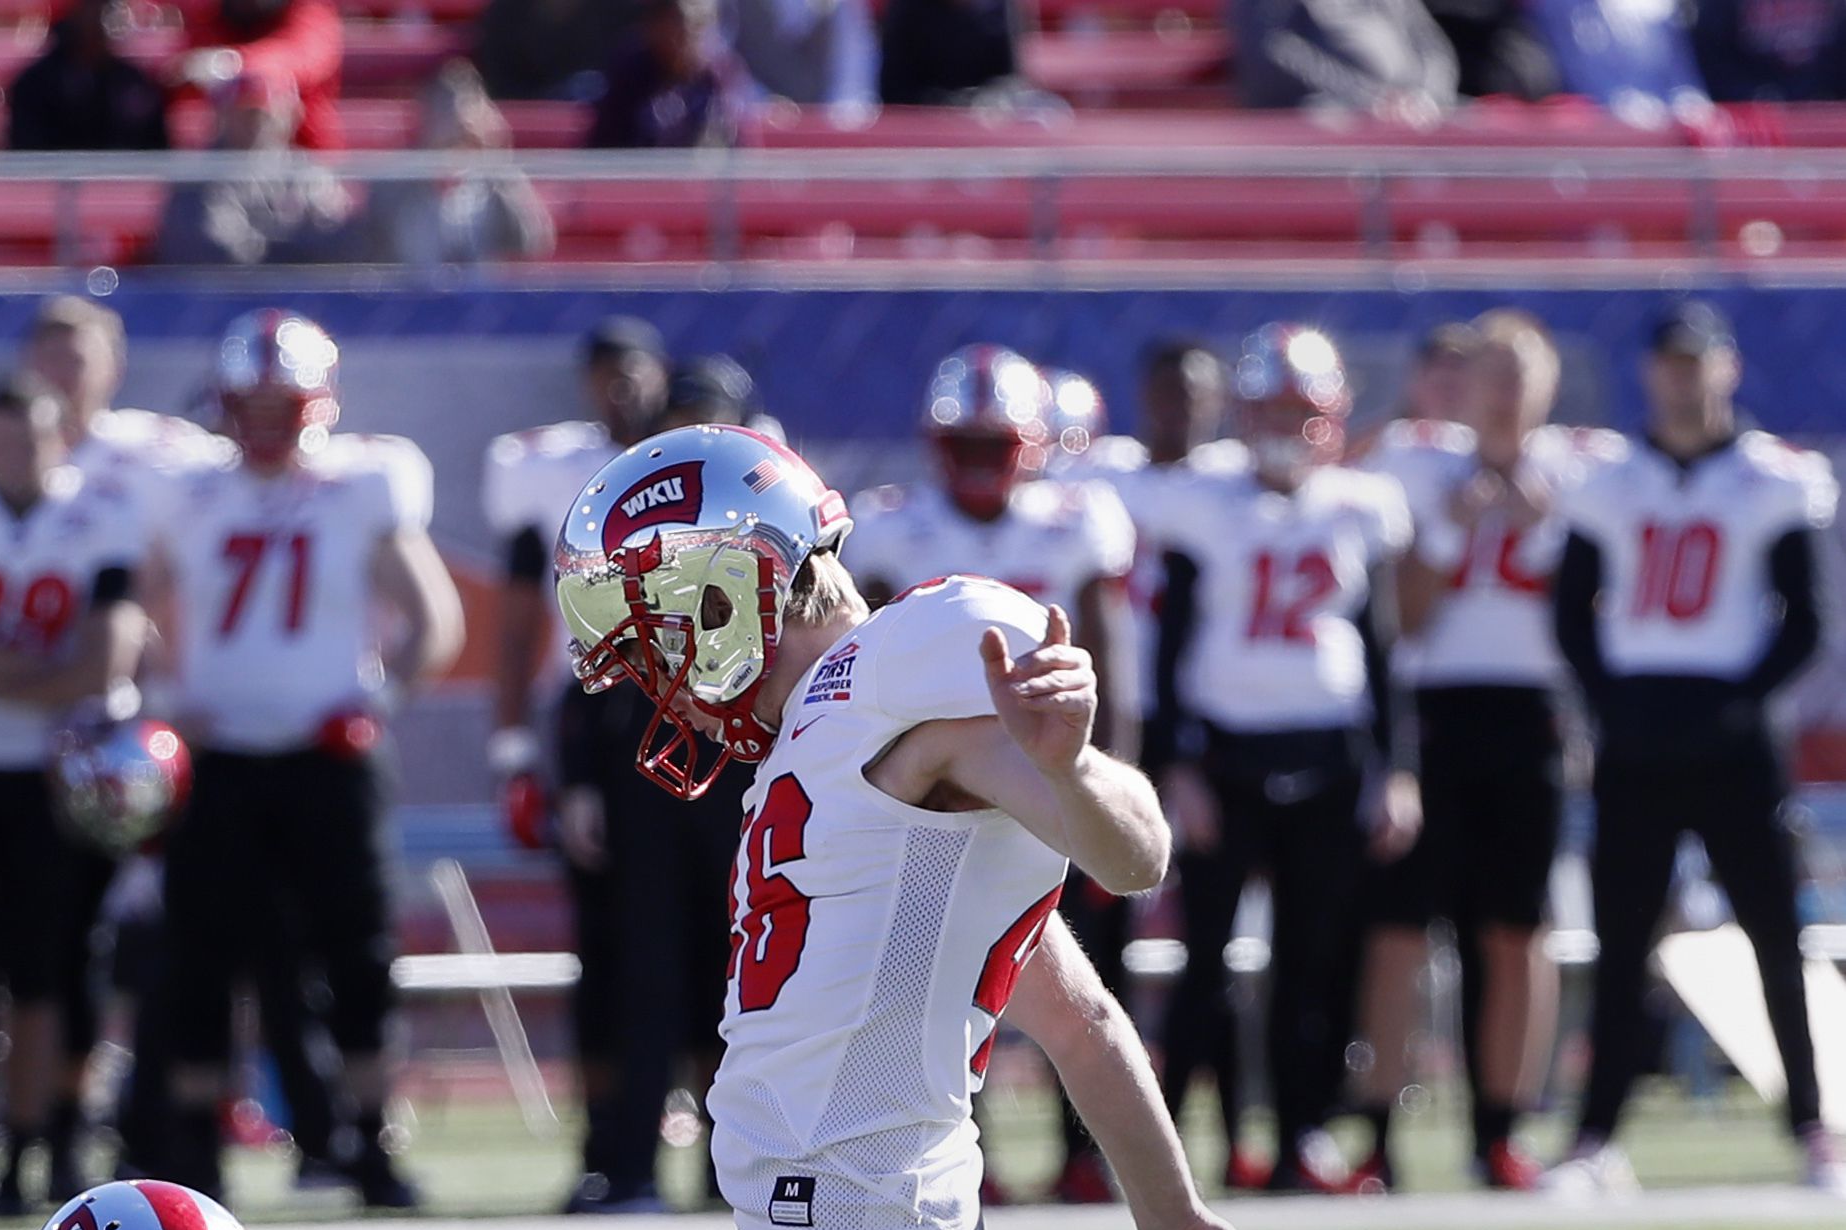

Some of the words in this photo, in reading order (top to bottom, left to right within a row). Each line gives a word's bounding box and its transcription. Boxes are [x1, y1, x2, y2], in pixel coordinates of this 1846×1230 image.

[620, 476, 685, 519] WKU
[216, 532, 311, 637] 71
[1248, 548, 1337, 646] 12
[1632, 520, 1720, 621] 10
[814, 656, 856, 682] FIRST
[784, 1182, 800, 1197] M
